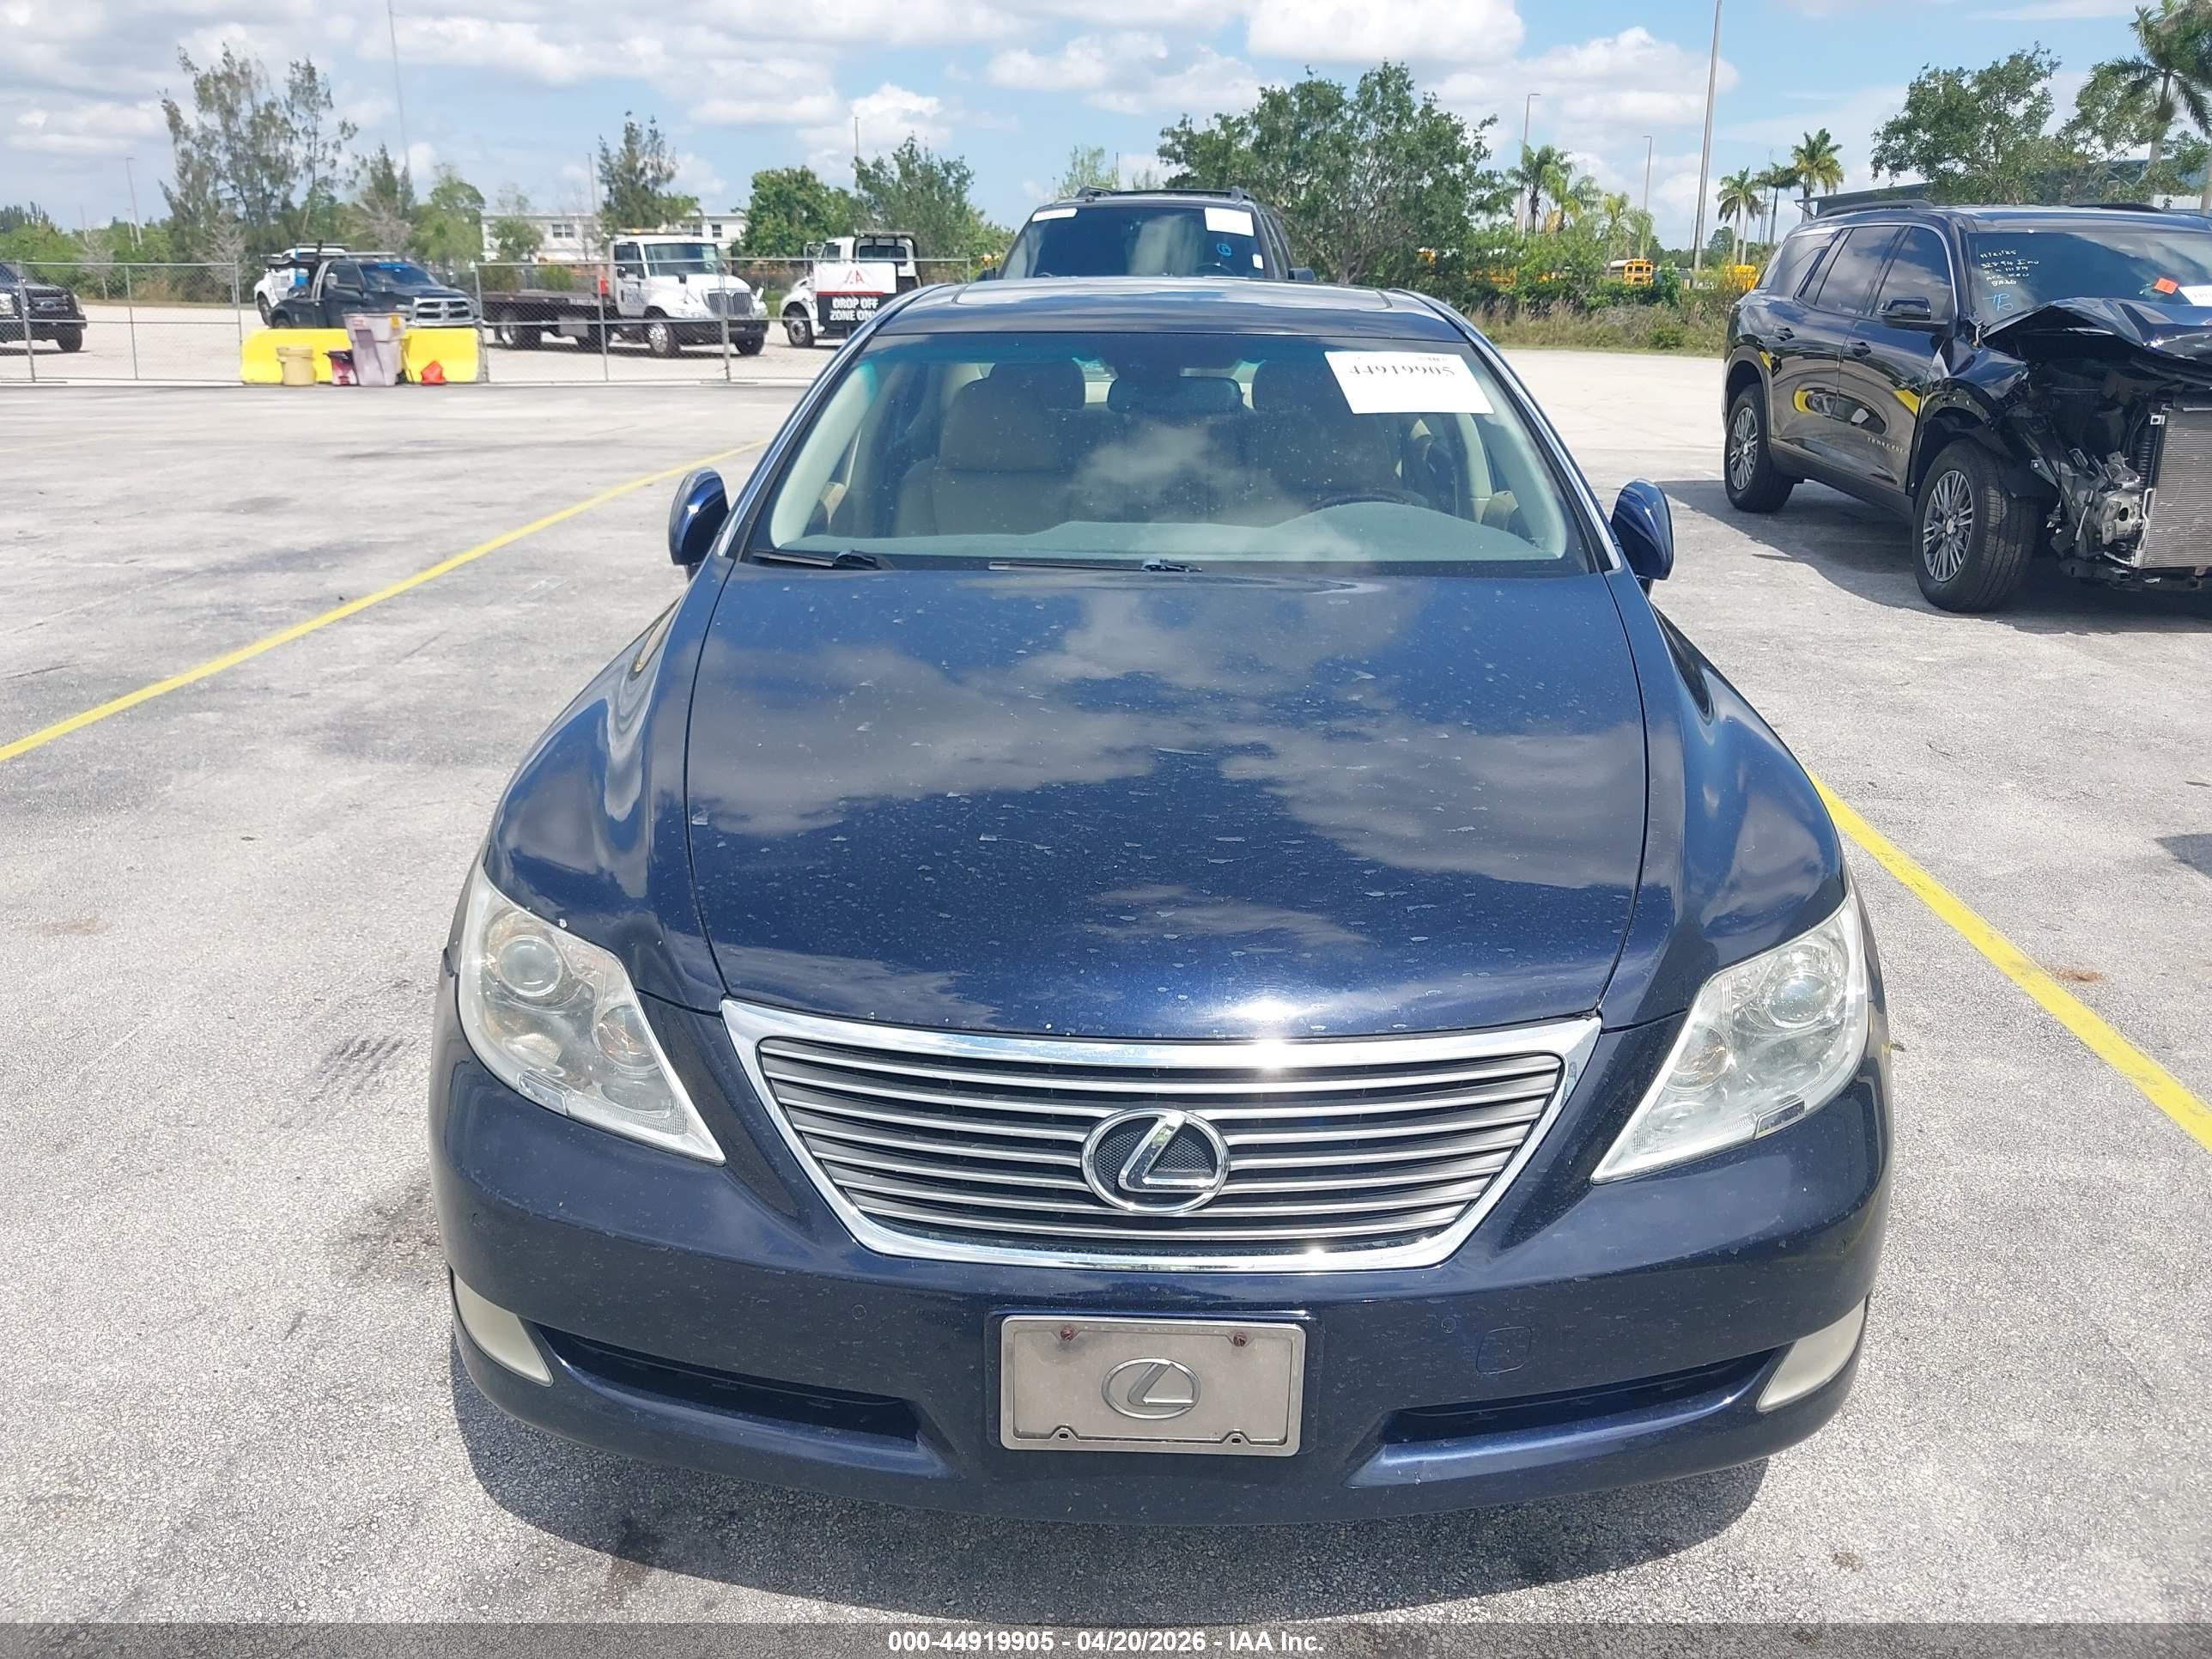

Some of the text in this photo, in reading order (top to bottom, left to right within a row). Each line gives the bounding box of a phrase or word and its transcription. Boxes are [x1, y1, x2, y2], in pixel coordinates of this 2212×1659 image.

[832, 297, 878, 308] DROP OFF
[830, 310, 855, 320] ZONE
